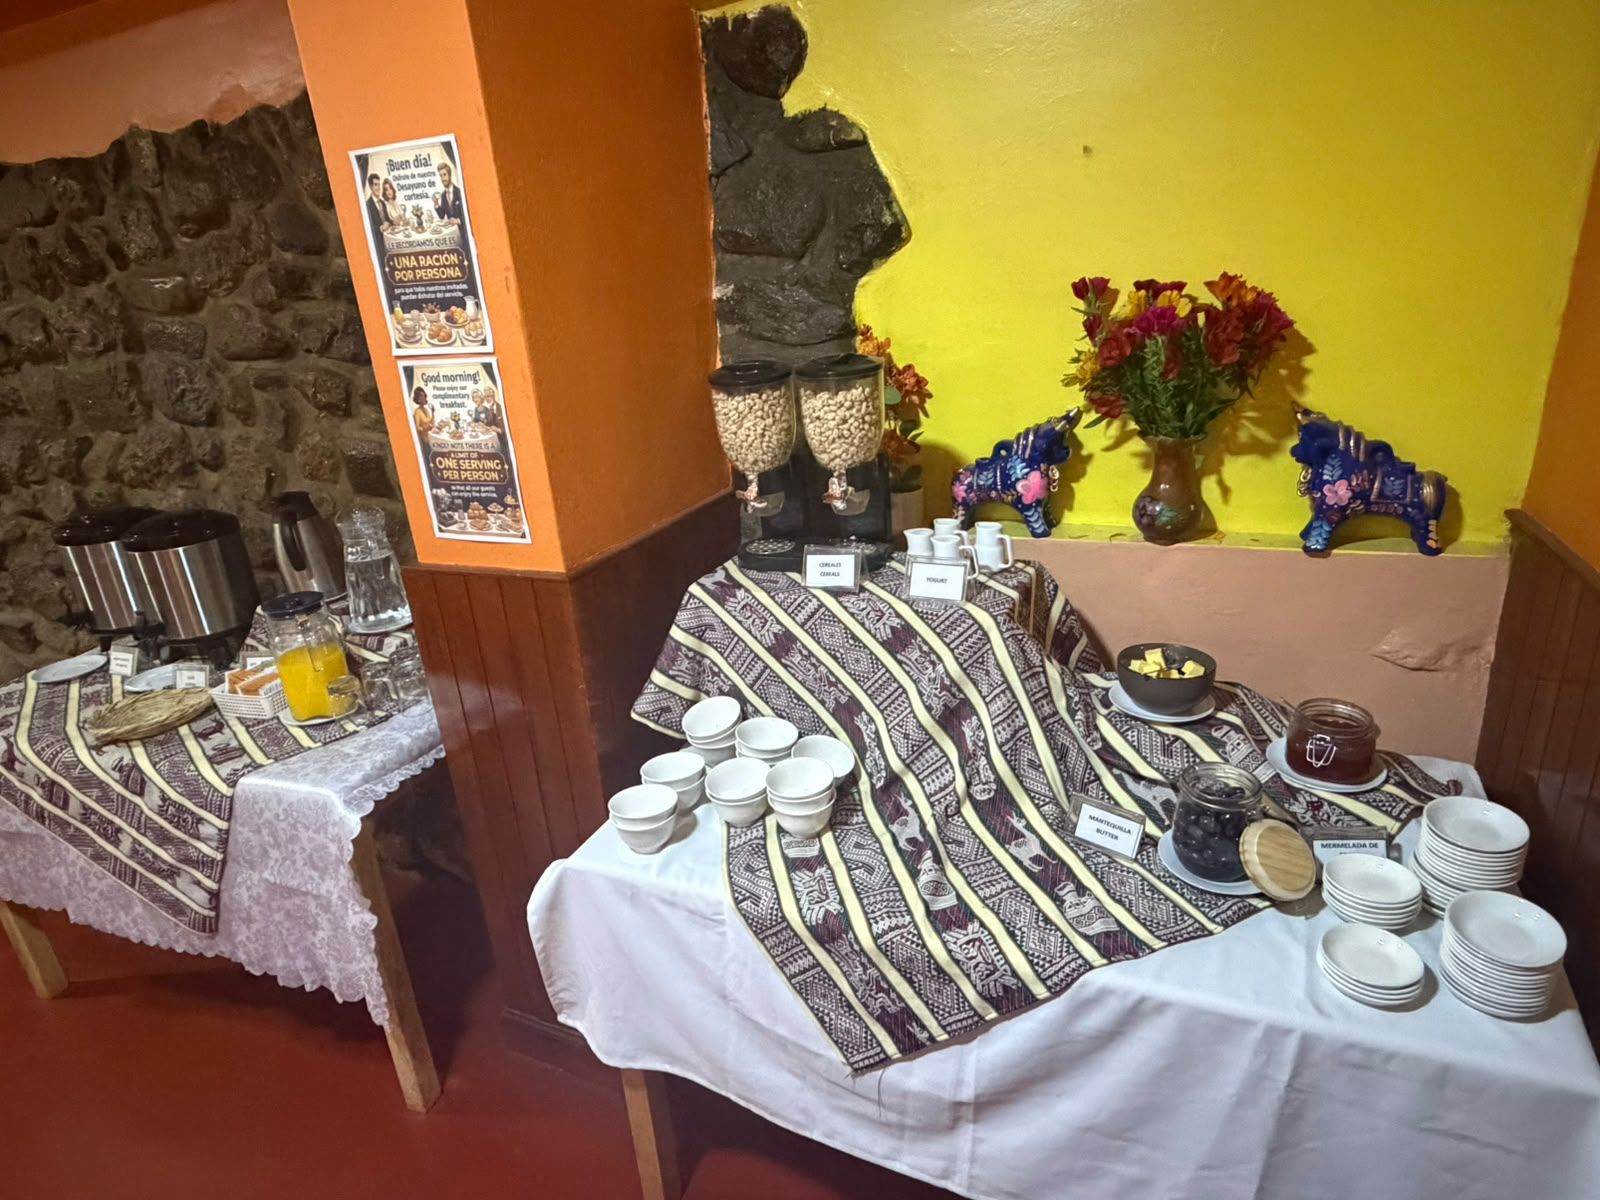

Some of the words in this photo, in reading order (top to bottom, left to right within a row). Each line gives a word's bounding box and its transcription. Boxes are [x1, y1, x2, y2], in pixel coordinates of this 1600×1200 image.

[386, 158, 411, 176] ¡Buen
[413, 152, 432, 169] día!
[397, 181, 427, 191] Desayuno
[428, 178, 436, 188] de
[435, 238, 448, 246] QUE
[394, 256, 418, 270] UNA
[419, 250, 459, 267] RACIÓN
[394, 270, 415, 282] POR
[416, 266, 462, 281] PERSONA
[421, 372, 441, 387] Good
[442, 370, 481, 385] morning!
[432, 392, 470, 401] complimentary
[459, 459, 502, 471] SERVING
[443, 470, 459, 480] PER
[460, 471, 500, 482] PERSON
[1088, 814, 1131, 835] MANTEQUILLA
[1096, 828, 1118, 840] BUTTER
